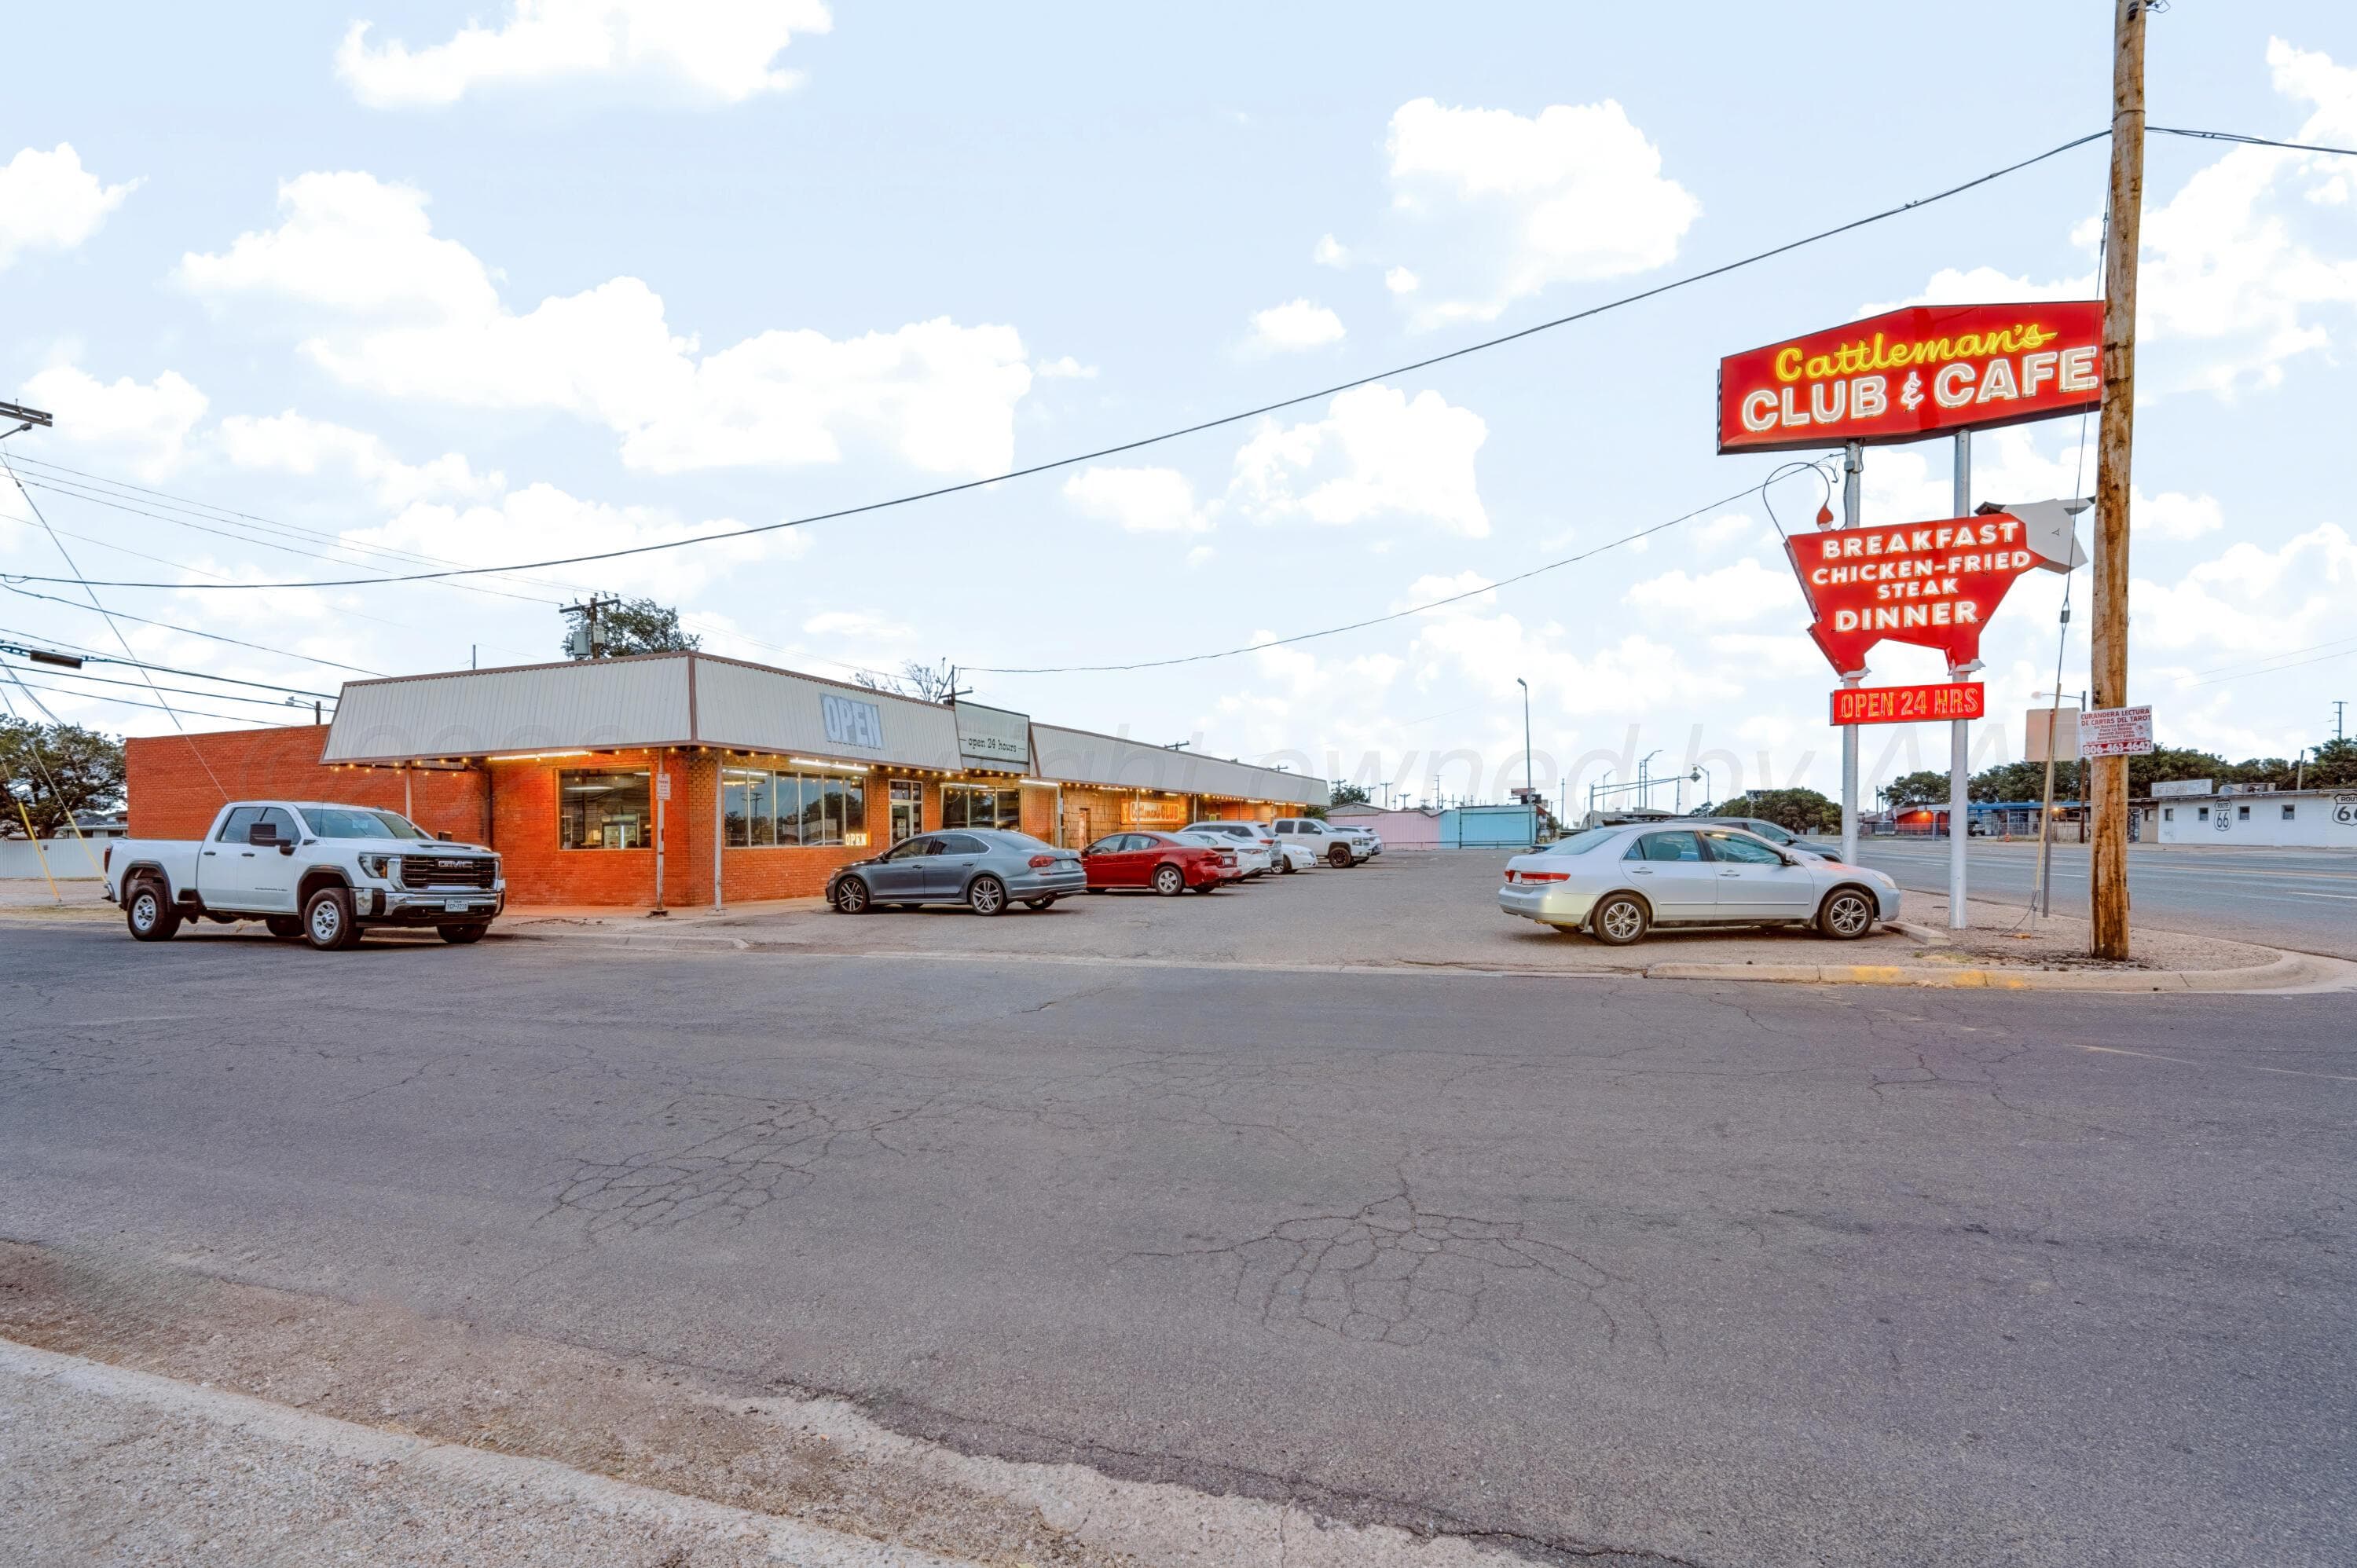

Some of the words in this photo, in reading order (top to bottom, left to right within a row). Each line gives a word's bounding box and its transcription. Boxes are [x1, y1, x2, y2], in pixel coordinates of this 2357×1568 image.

[1775, 323, 2058, 382] Cattleman's
[1741, 375, 1887, 433] CLUB
[1901, 371, 1924, 413] &
[1934, 346, 2099, 408] CAFE
[1822, 522, 2018, 559] BREAKFAST
[1812, 551, 2031, 585] CHICKEN-FRIED
[1877, 578, 1959, 599] STEAK
[1835, 601, 1978, 632] DINNER
[1841, 691, 1895, 719] OPEN
[1901, 690, 1927, 716] 24
[1935, 687, 1979, 714] HRS
[825, 696, 882, 746] OPEN
[2080, 710, 2120, 720] CURANDERA
[968, 738, 986, 749] open
[988, 738, 996, 748] 24
[998, 739, 1017, 753] hours
[2084, 740, 2151, 754] 806-463-4642
[1161, 804, 1178, 820] CLUB
[2216, 811, 2229, 829] 66
[2337, 806, 2357, 822] 6
[845, 833, 867, 846] OPEN
